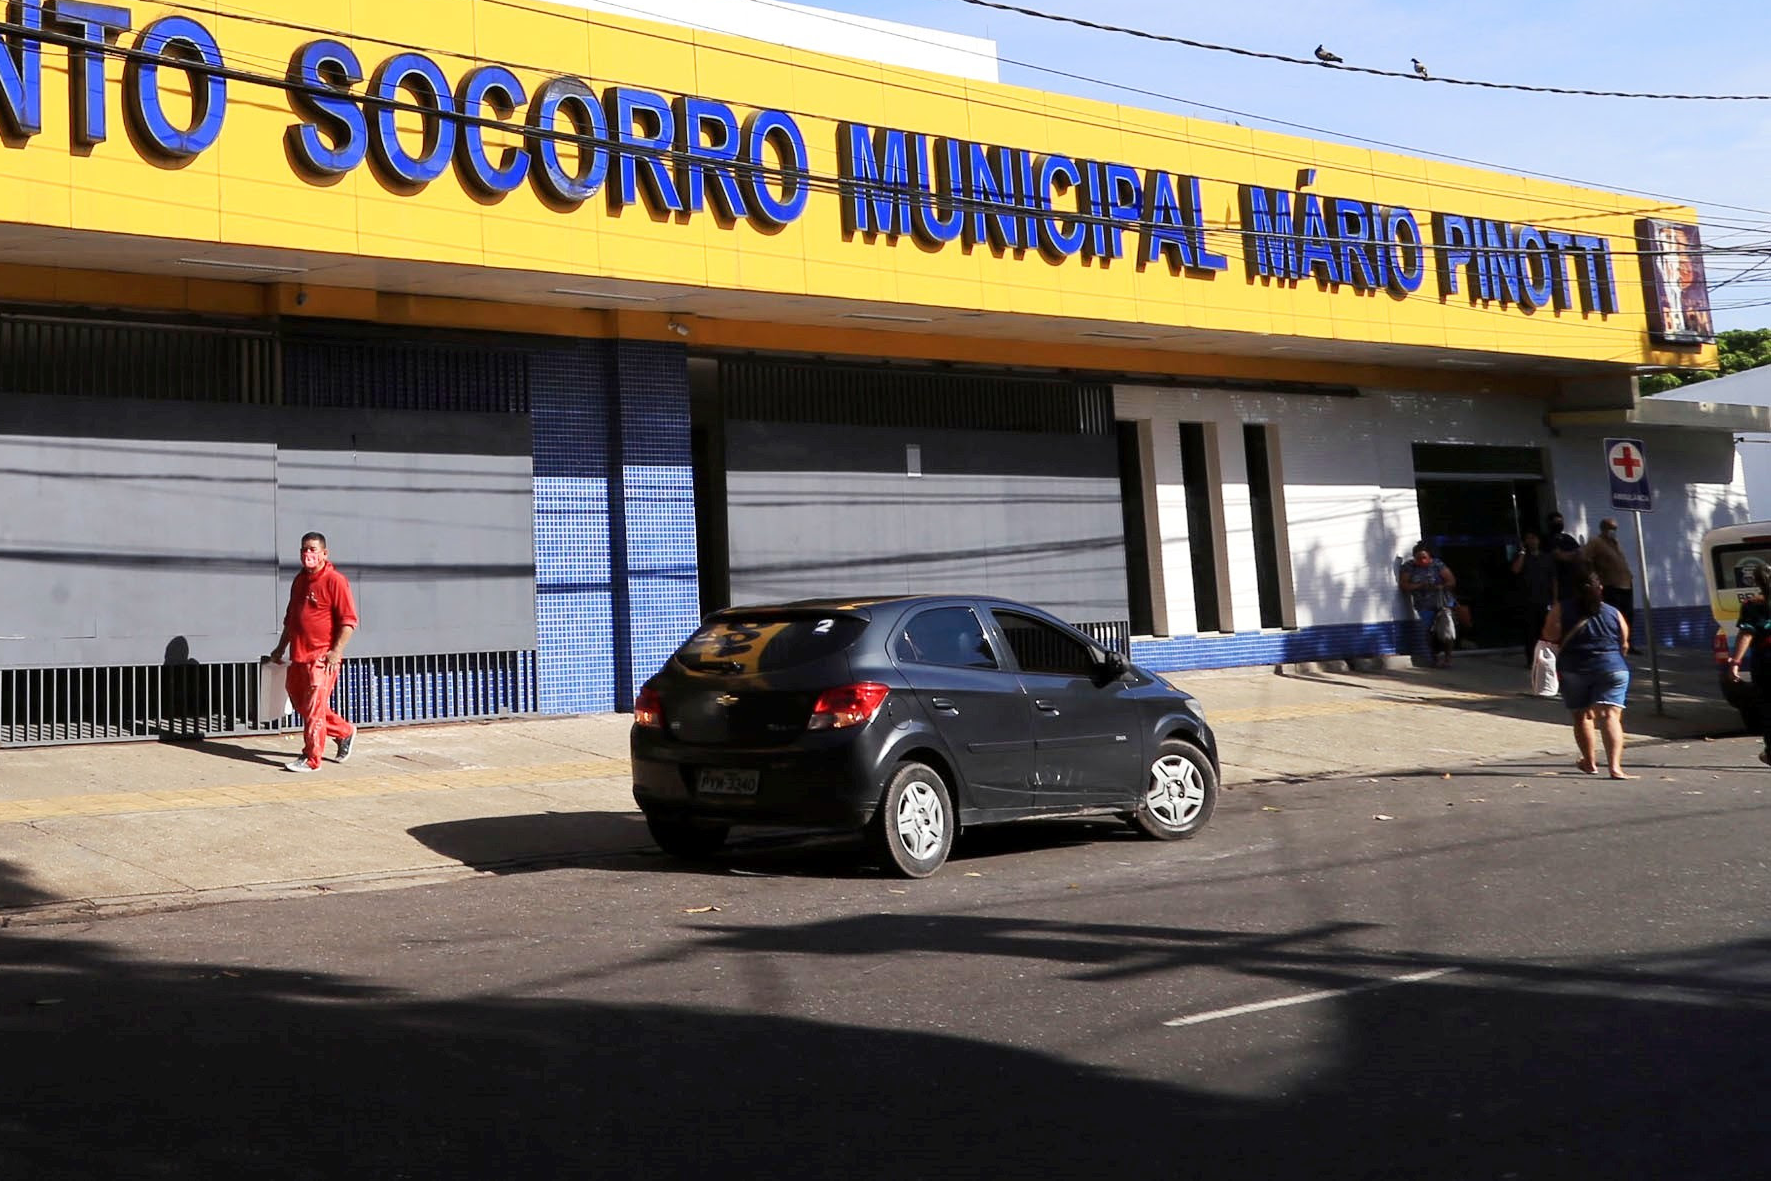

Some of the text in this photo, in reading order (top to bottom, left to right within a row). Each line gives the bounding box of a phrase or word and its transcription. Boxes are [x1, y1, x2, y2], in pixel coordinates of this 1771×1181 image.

[285, 39, 808, 229] SOCORRO
[837, 121, 1228, 275] MUNICIPAL
[1238, 169, 1424, 296] MÁRIO
[1432, 212, 1618, 317] PINOTTI
